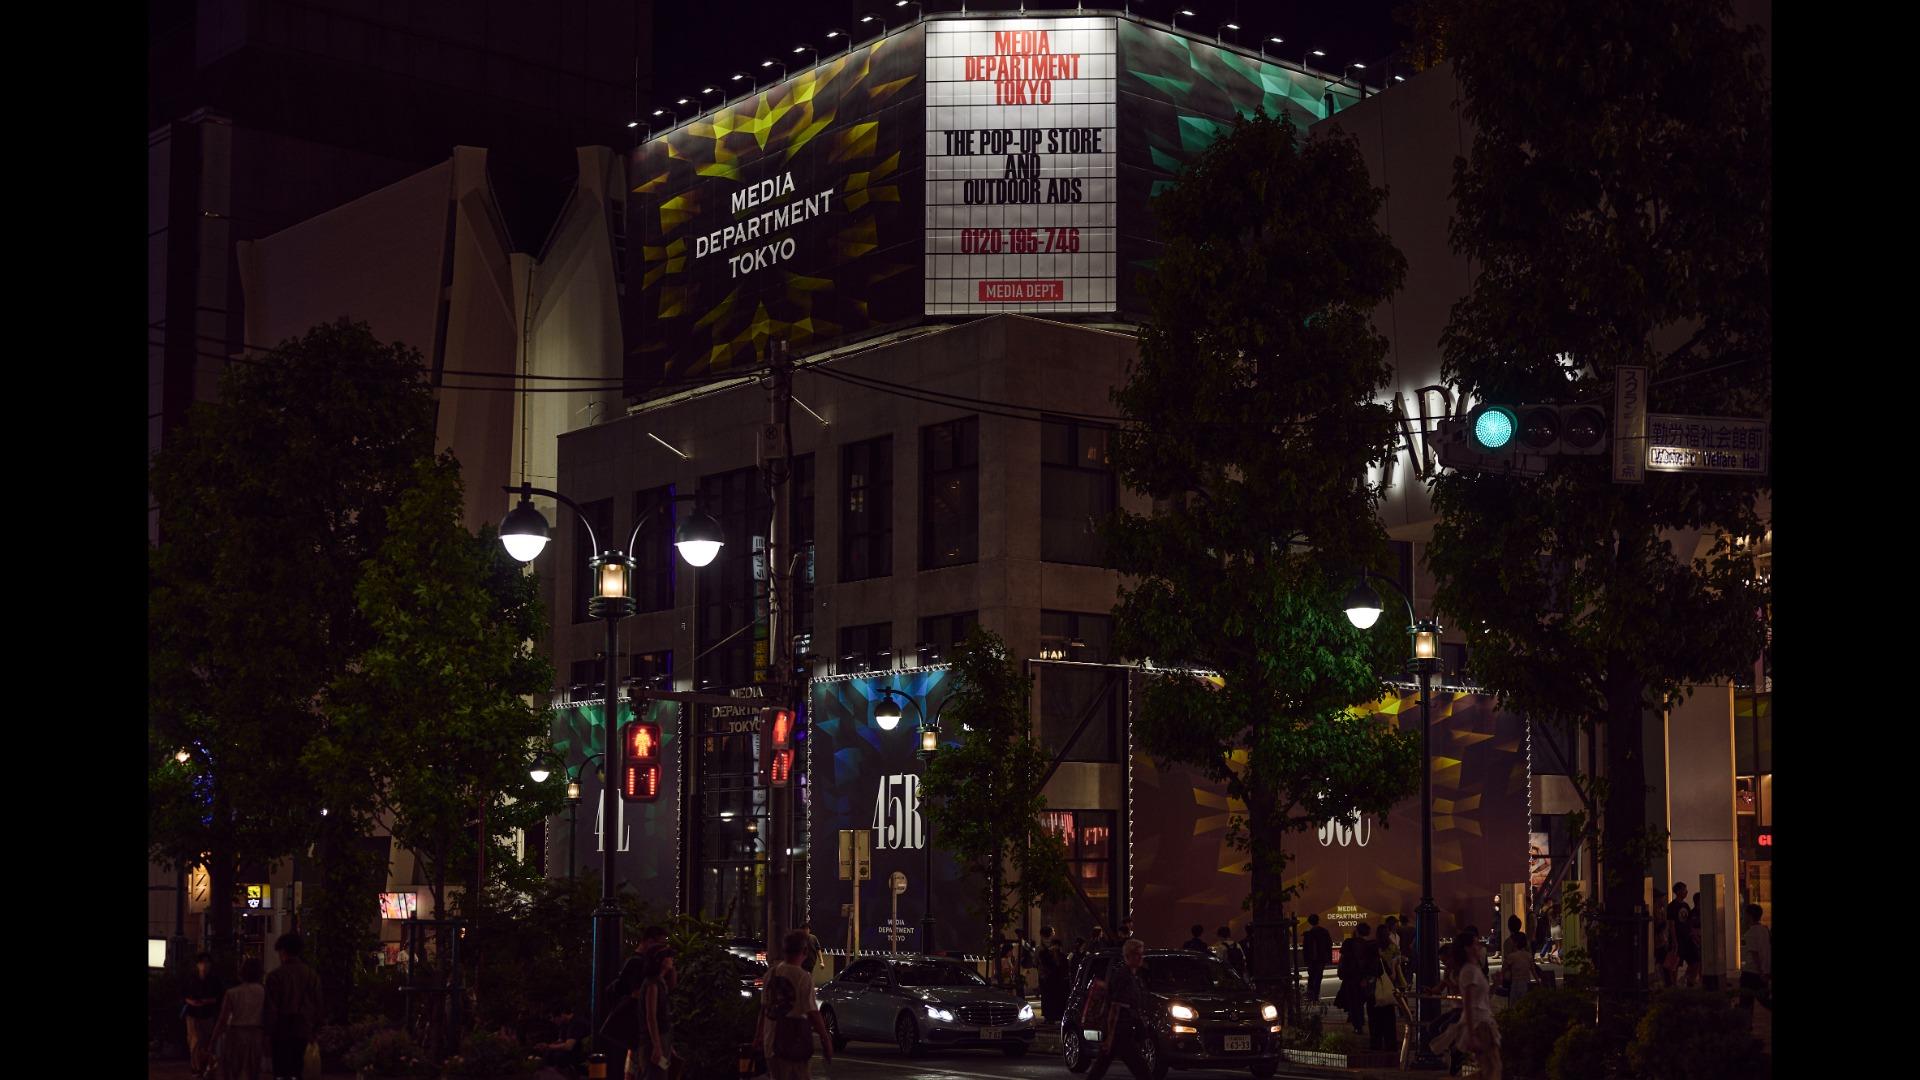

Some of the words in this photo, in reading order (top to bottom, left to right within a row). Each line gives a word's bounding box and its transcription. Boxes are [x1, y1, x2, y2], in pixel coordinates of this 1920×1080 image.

[995, 31, 1049, 55] MEDIA
[965, 55, 1080, 81] DEPARTMENT
[994, 80, 1052, 105] TOKYO
[944, 130, 975, 156] THE
[981, 129, 1042, 155] POP-UP
[1048, 128, 1102, 154] STORE
[1006, 154, 1041, 179] AND
[730, 172, 795, 214] MEDIA
[964, 179, 1042, 205] OUTDOOR
[1047, 178, 1082, 203] ADS
[695, 189, 834, 259] DEPARTMENT
[961, 228, 1080, 254] 0120-195-746
[728, 238, 796, 279] TOKYO
[986, 284, 1023, 299] MEDIA
[1026, 284, 1059, 298] DEPT.
[1652, 422, 1762, 449] 勤労福祉会館前
[730, 687, 764, 699] MEDIA
[872, 772, 926, 850] 45R
[1327, 912, 1368, 920] DEPARTMENT
[878, 926, 914, 934] DEPATMENT
